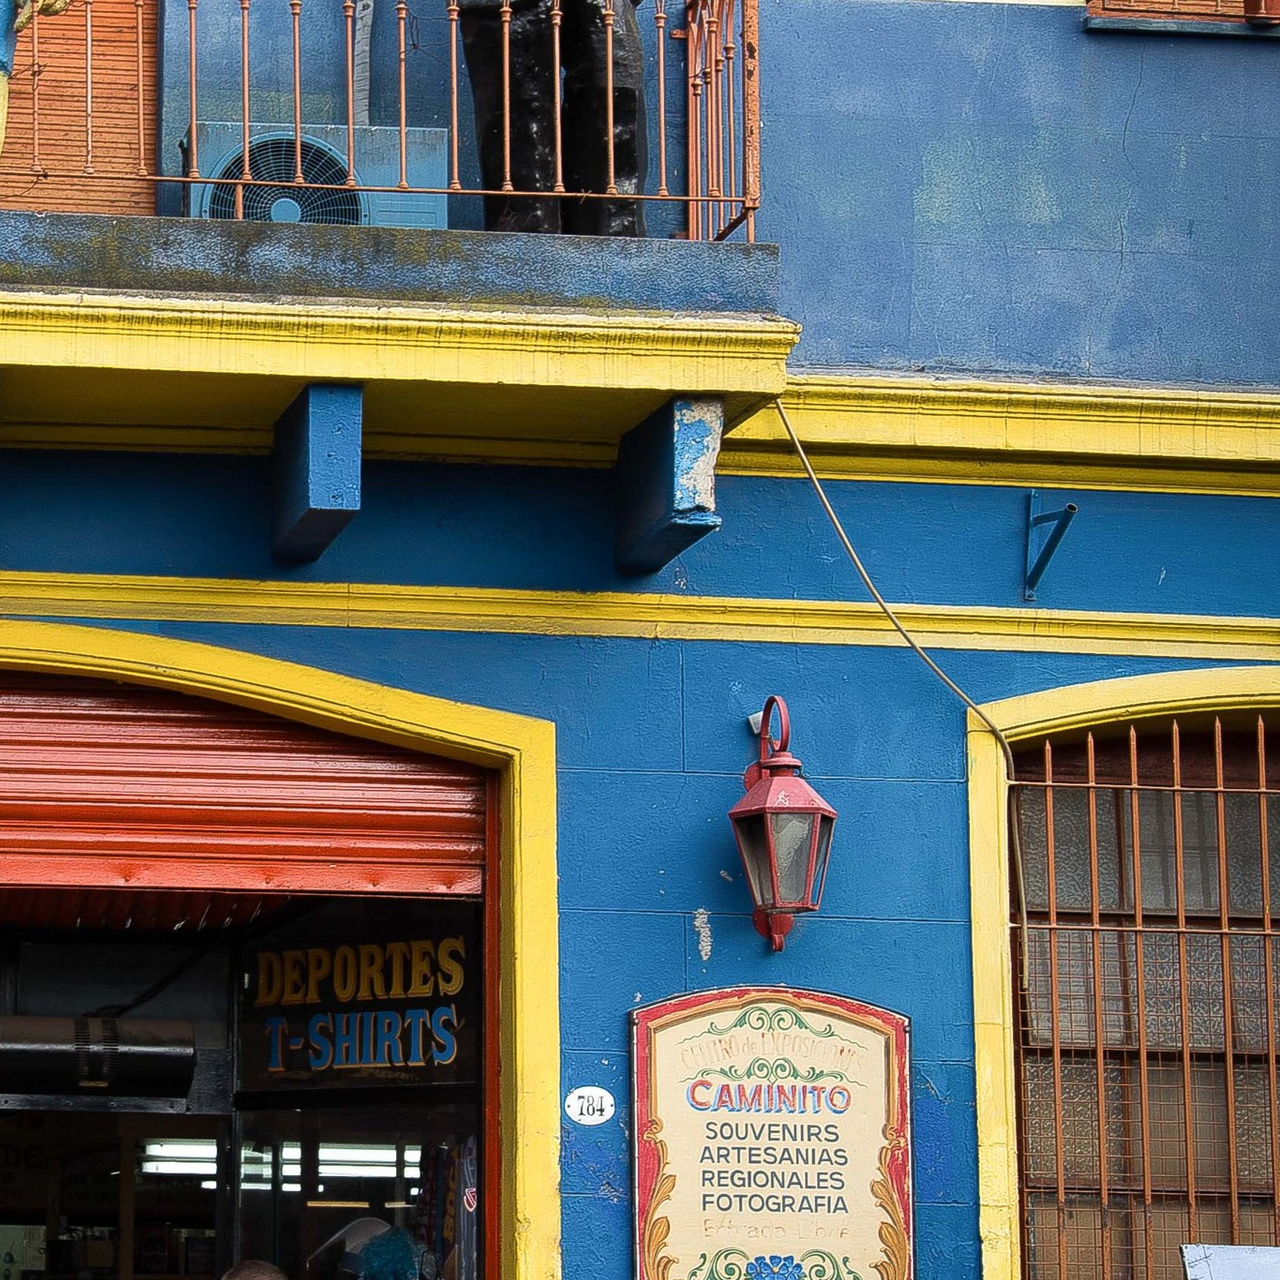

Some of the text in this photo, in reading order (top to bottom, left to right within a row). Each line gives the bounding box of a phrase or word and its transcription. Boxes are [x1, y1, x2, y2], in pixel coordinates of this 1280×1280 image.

[254, 935, 466, 1007] DEPORTES
[265, 1003, 460, 1072] T-SHIRTS
[577, 1095, 605, 1117] 784
[686, 1079, 852, 1115] CAMINITO
[705, 1121, 840, 1143] SOUVENIRS
[699, 1146, 849, 1166] ARTESANIAS
[701, 1169, 845, 1190] REGIONALES
[702, 1193, 849, 1214] FOTOGRAFIA
